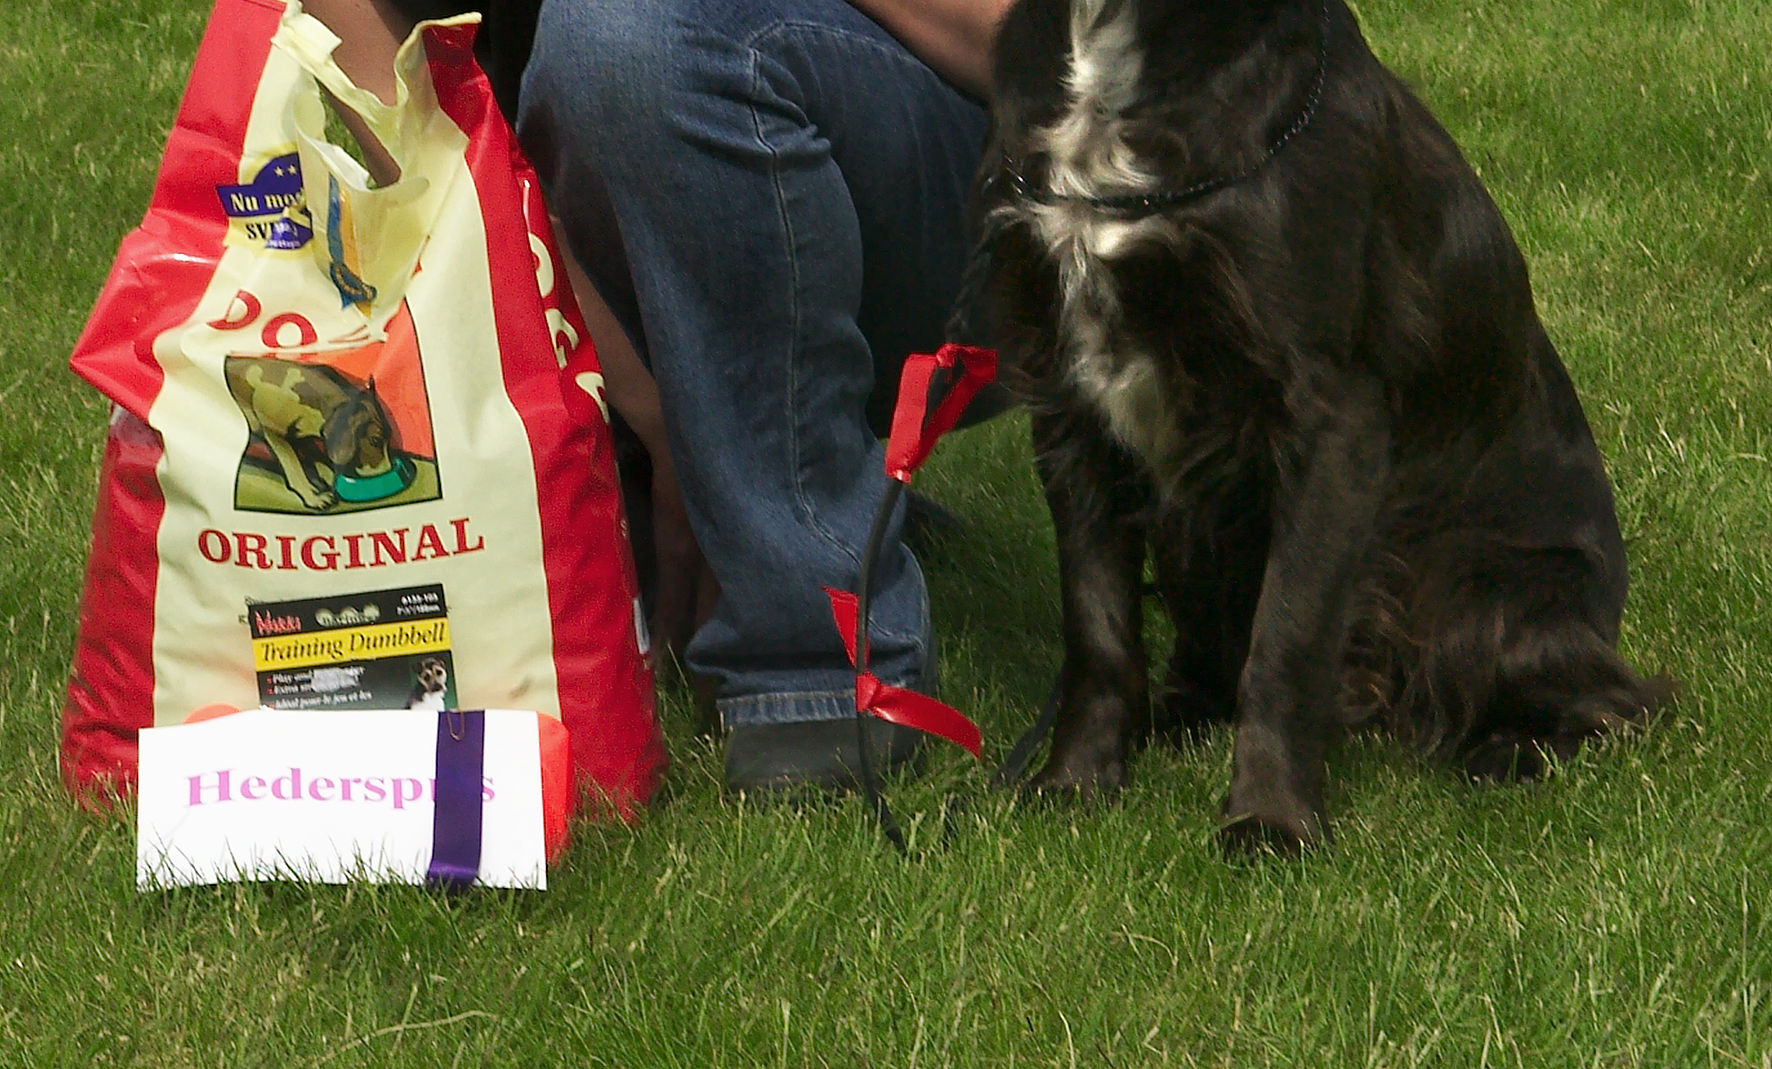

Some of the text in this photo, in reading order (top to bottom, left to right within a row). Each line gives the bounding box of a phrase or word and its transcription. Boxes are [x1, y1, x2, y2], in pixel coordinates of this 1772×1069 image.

[230, 192, 259, 213] Nu
[198, 518, 485, 570] ORIGINAL
[261, 622, 445, 661] Training Dumbbell
[185, 766, 495, 810] Hedersps
